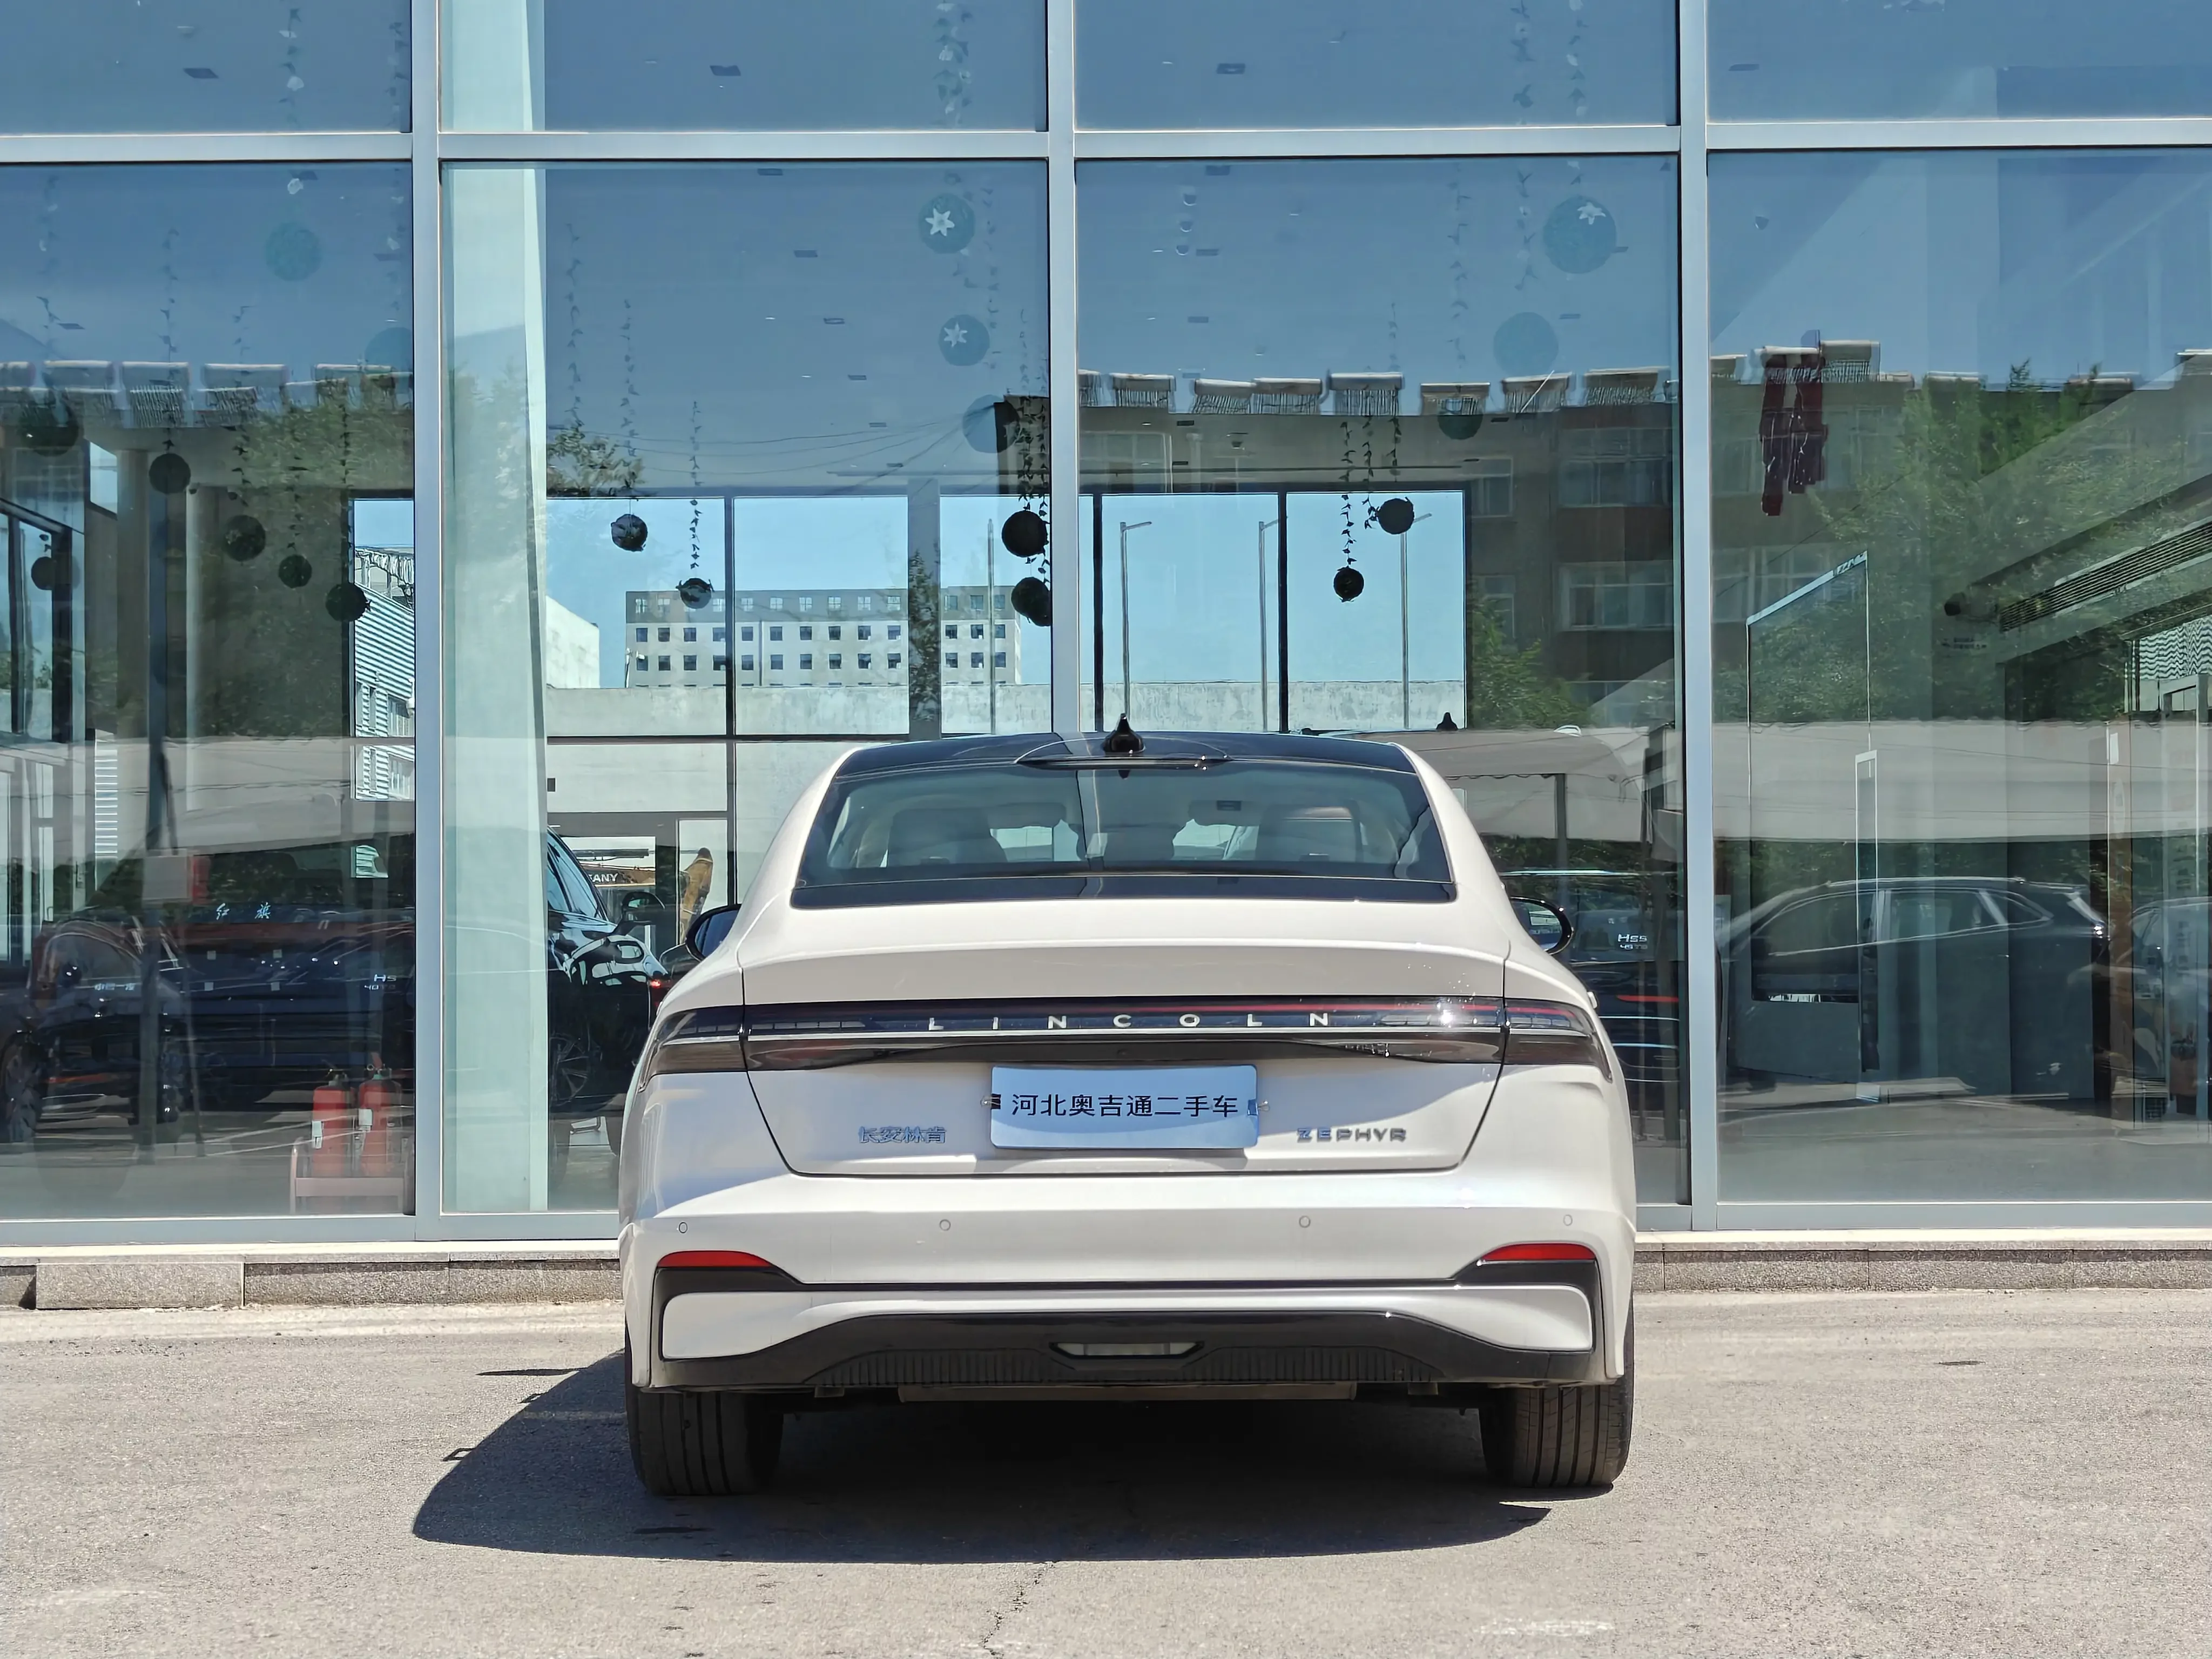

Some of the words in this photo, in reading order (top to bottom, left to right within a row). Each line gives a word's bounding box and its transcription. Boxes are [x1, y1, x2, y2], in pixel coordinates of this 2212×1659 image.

[928, 1013, 1328, 1030] LINCOLN
[1011, 1094, 1239, 1117] 河北奥吉通二手车
[858, 1126, 947, 1143] 长安林肯
[1297, 1128, 1406, 1143] ZEPHYR
